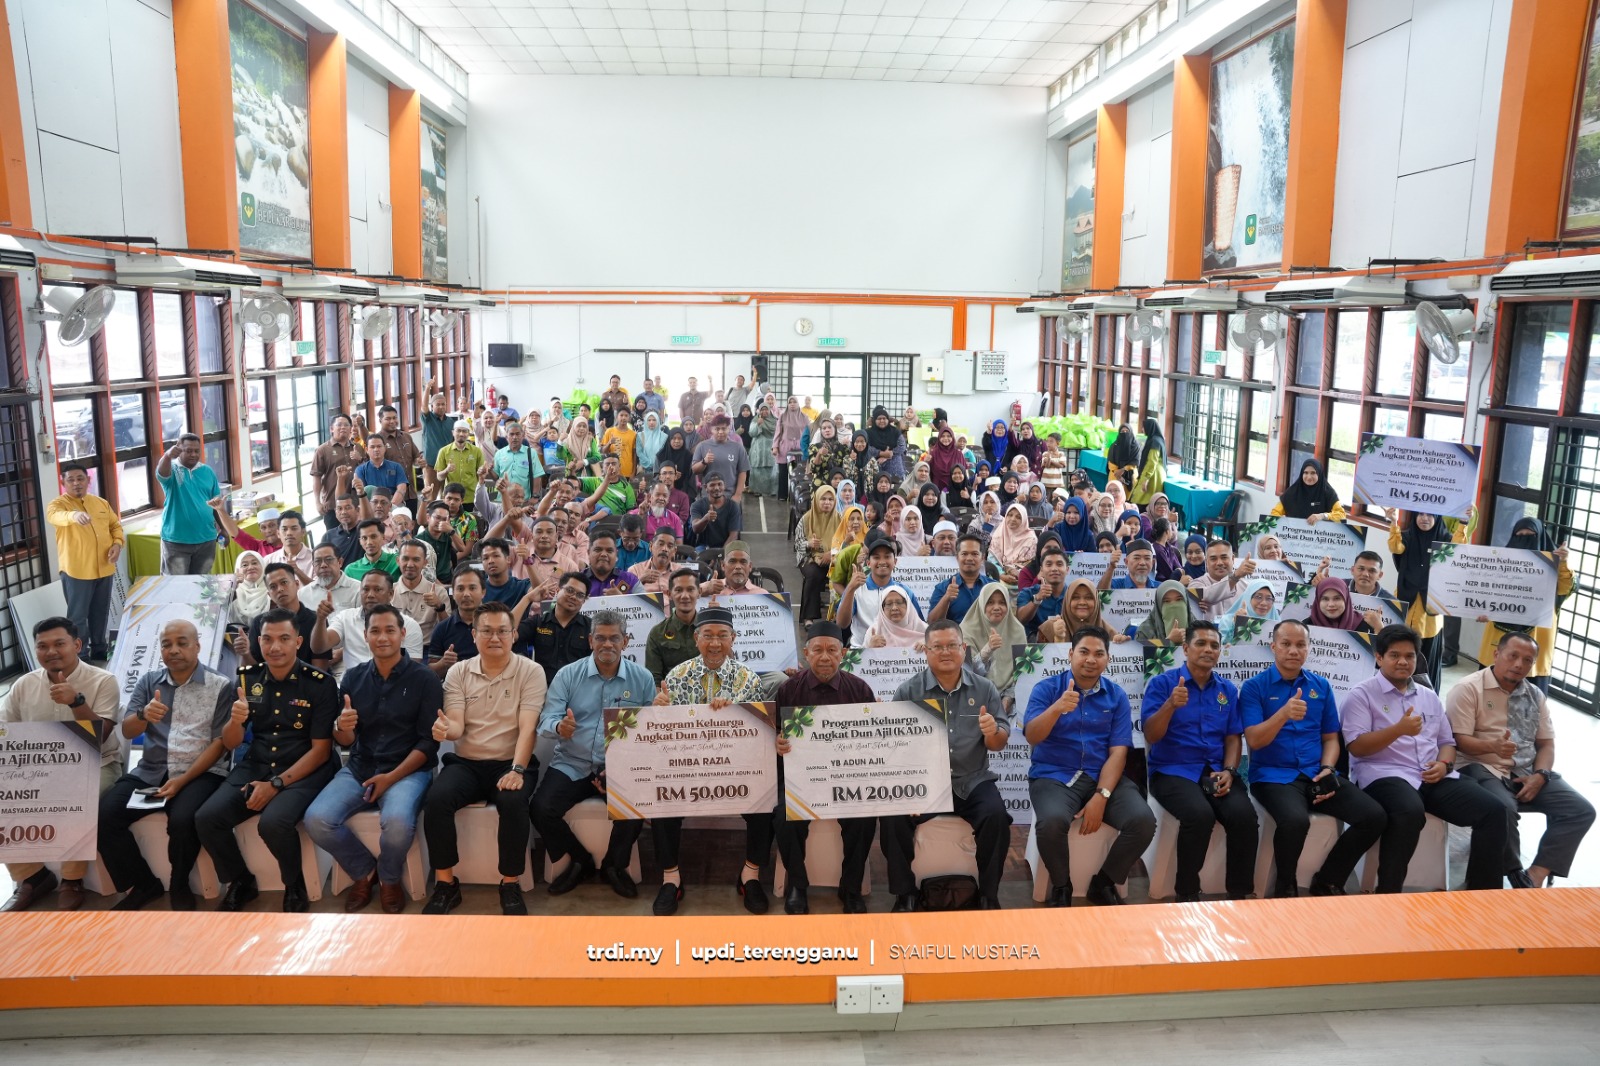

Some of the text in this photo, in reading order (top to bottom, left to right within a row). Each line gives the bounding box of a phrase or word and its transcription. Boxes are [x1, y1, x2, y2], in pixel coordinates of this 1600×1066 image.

[1389, 446, 1456, 458] Program Keluarga
[1379, 452, 1405, 460] Angkat
[1437, 459, 1464, 467] (KADA)
[1390, 471, 1419, 479] SAFWANG
[1421, 474, 1456, 484] RESOURCES
[1390, 488, 1446, 504] RM 5,000
[1282, 526, 1345, 538] Program Keluarga
[1460, 554, 1533, 567] Program Keluarga
[1451, 561, 1478, 569] Angkat
[1498, 564, 1511, 573] Ajil
[1513, 566, 1544, 575] (KADA)
[1492, 582, 1532, 592] ENTERPRISE
[1465, 598, 1526, 613] RM 5,000
[1309, 638, 1349, 650] Keluarga
[742, 650, 765, 662] 500
[1310, 647, 1360, 660] Ajil (KADA)
[1233, 671, 1249, 681] Ajil
[1333, 673, 1349, 682] AJIL
[646, 719, 744, 731] Program Keluarga
[822, 716, 918, 729] Program Keluarga
[635, 728, 758, 743] Angkat Dun Ajil (KADA)
[810, 725, 933, 742] Angkat Dun Ajil (KADA)
[6, 740, 65, 752] Keluarga
[8, 752, 81, 767] Ajil (KADA)
[669, 759, 700, 767] RIMBA
[702, 757, 730, 765] RAZIA
[997, 752, 1011, 761] Ajil
[657, 786, 686, 801] RM
[690, 784, 749, 802] 50,000
[832, 787, 863, 802] RM
[866, 784, 927, 801] 20,000
